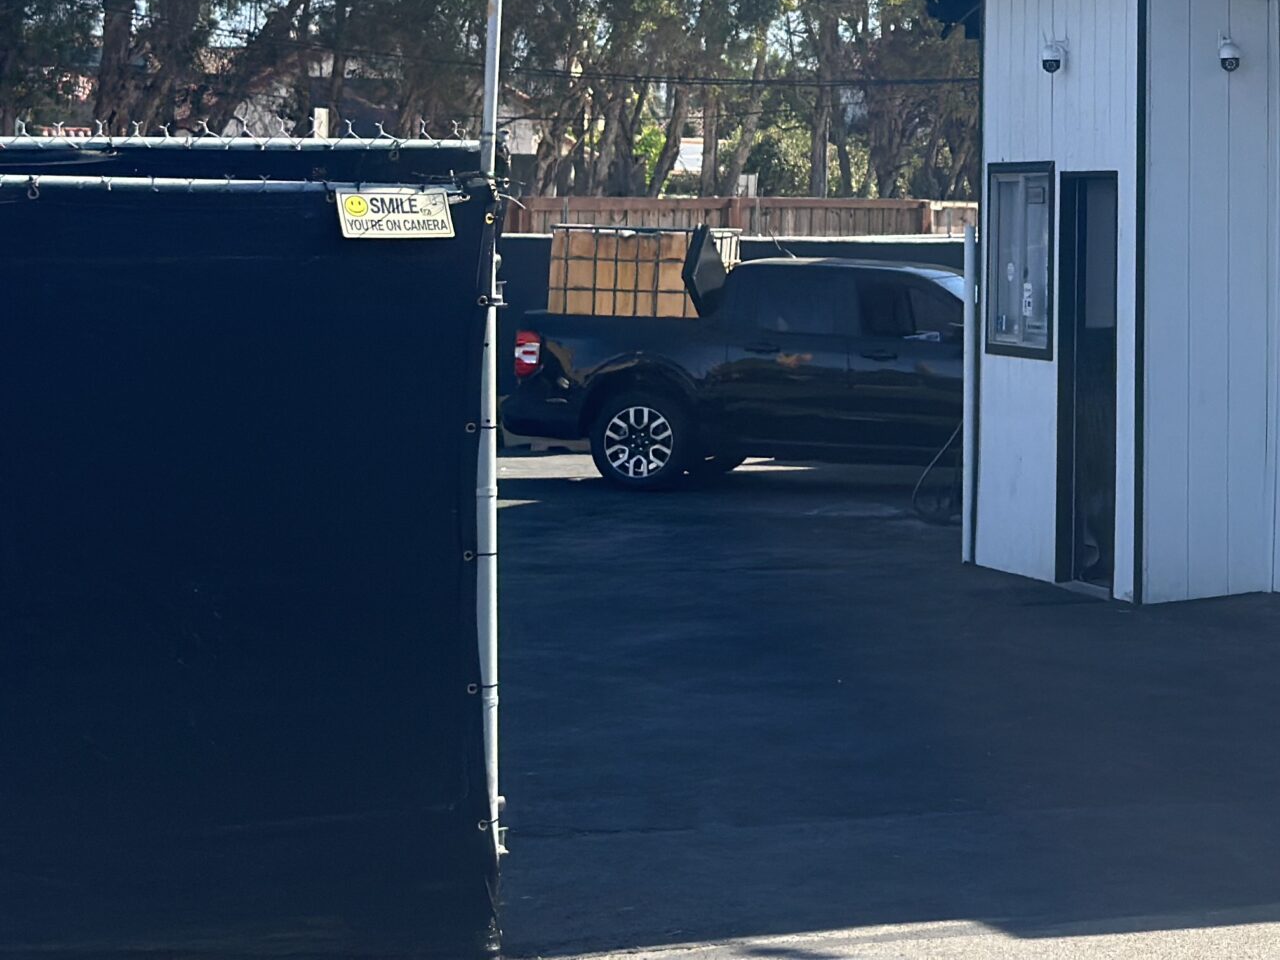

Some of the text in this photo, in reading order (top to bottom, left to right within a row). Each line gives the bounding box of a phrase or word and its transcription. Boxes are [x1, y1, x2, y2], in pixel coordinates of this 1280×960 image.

[370, 197, 419, 214] SMILE
[347, 219, 448, 232] YOU'RE ON CAMERA
